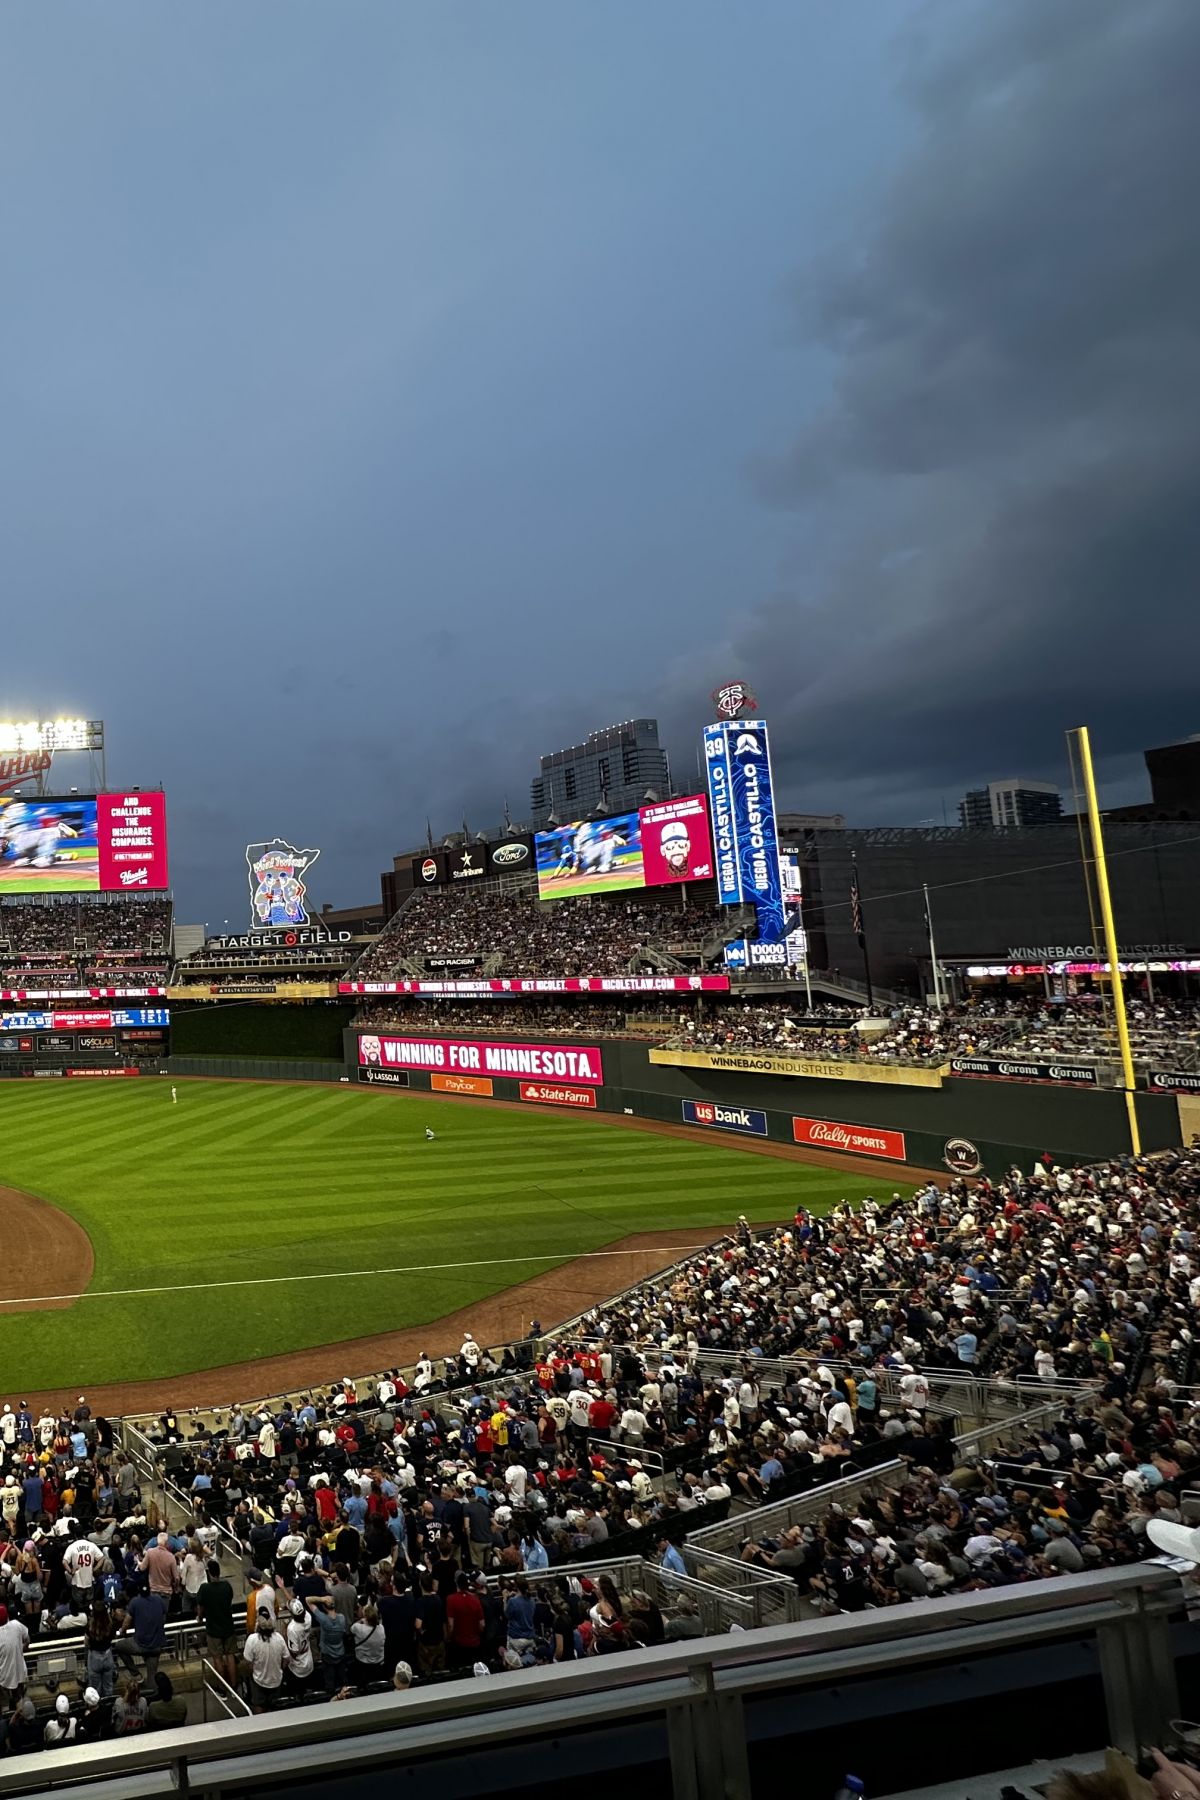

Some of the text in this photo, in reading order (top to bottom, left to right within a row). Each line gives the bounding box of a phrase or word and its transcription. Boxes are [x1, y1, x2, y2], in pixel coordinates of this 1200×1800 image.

[706, 738, 724, 758] 39
[124, 797, 138, 806] AND
[744, 764, 764, 848] CASTILLO
[111, 807, 152, 816] CHALLENGE
[713, 767, 731, 850] CASTILLO
[125, 818, 138, 826] THE
[112, 827, 152, 836] INSURANCE
[111, 837, 154, 846] COMPANIES.
[500, 847, 521, 861] Ford
[722, 861, 735, 892] DIEGO
[753, 860, 769, 890] DIEGO
[220, 931, 351, 947] TARGET FIELD
[751, 944, 784, 954] 10000
[1008, 946, 1095, 958] WINNEBAGO
[752, 955, 785, 964] LAKES
[536, 980, 567, 990] NICOLET.
[602, 978, 675, 990] NICOLETLAW.COM
[384, 1041, 599, 1078] WINNING FOR MINNESOTA.
[952, 1059, 989, 1072] Corona
[711, 1057, 843, 1076] WINNEBAGO INDUSTRIES
[999, 1062, 1039, 1076] Corona
[1049, 1065, 1093, 1080] Corona
[374, 1073, 399, 1082] LASSO.AI
[1154, 1073, 1200, 1089] Coron
[446, 1079, 476, 1090] Paycor
[715, 1108, 751, 1126] bank
[809, 1123, 886, 1150] Bally SPORTS
[957, 1151, 966, 1160] W
[539, 1371, 550, 1380] 49
[577, 1399, 588, 1410] 30
[428, 1530, 441, 1543] 34
[77, 1554, 91, 1567] 49
[108, 1586, 116, 1600] 4
